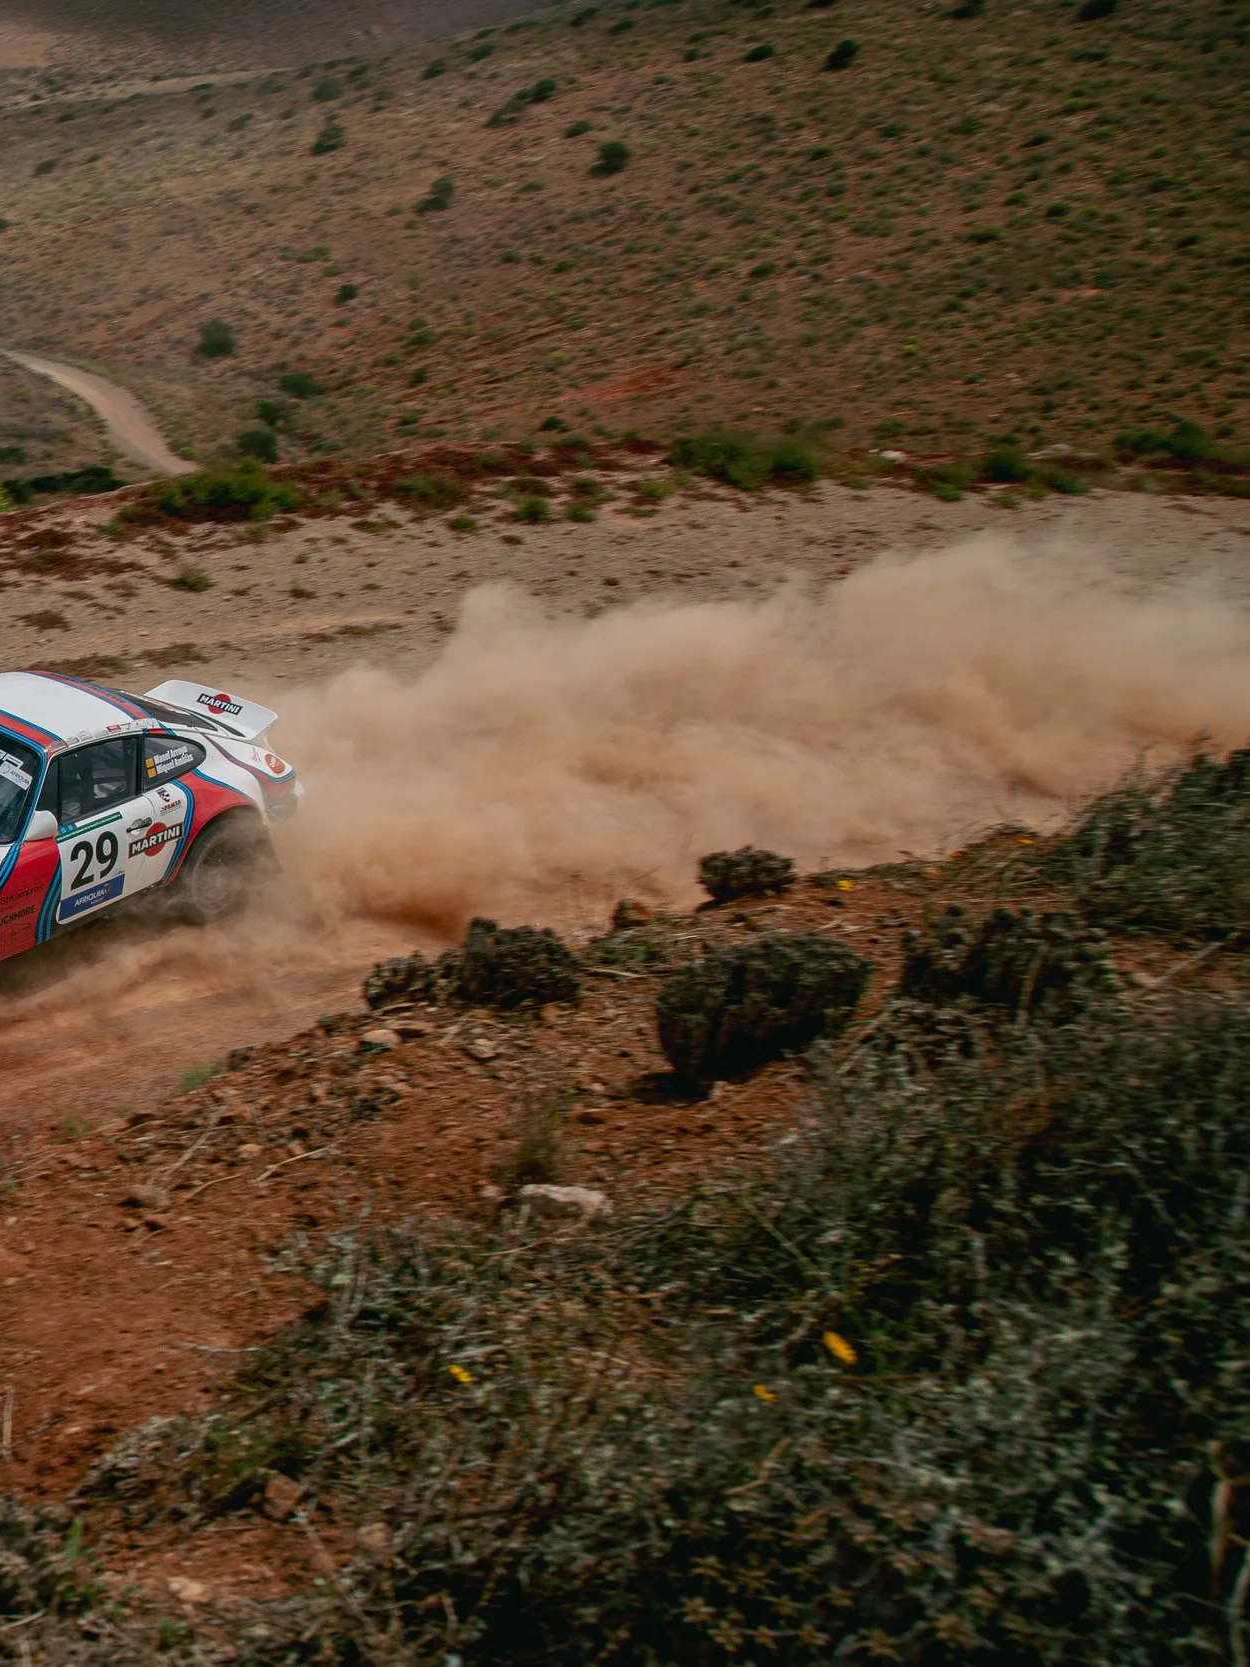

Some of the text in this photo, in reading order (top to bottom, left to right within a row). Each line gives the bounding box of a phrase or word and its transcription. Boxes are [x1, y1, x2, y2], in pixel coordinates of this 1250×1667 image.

[199, 695, 240, 714] MARTINI
[131, 825, 181, 855] MARTINI
[70, 830, 119, 892] 29
[73, 888, 105, 908] AFRIQUIA
